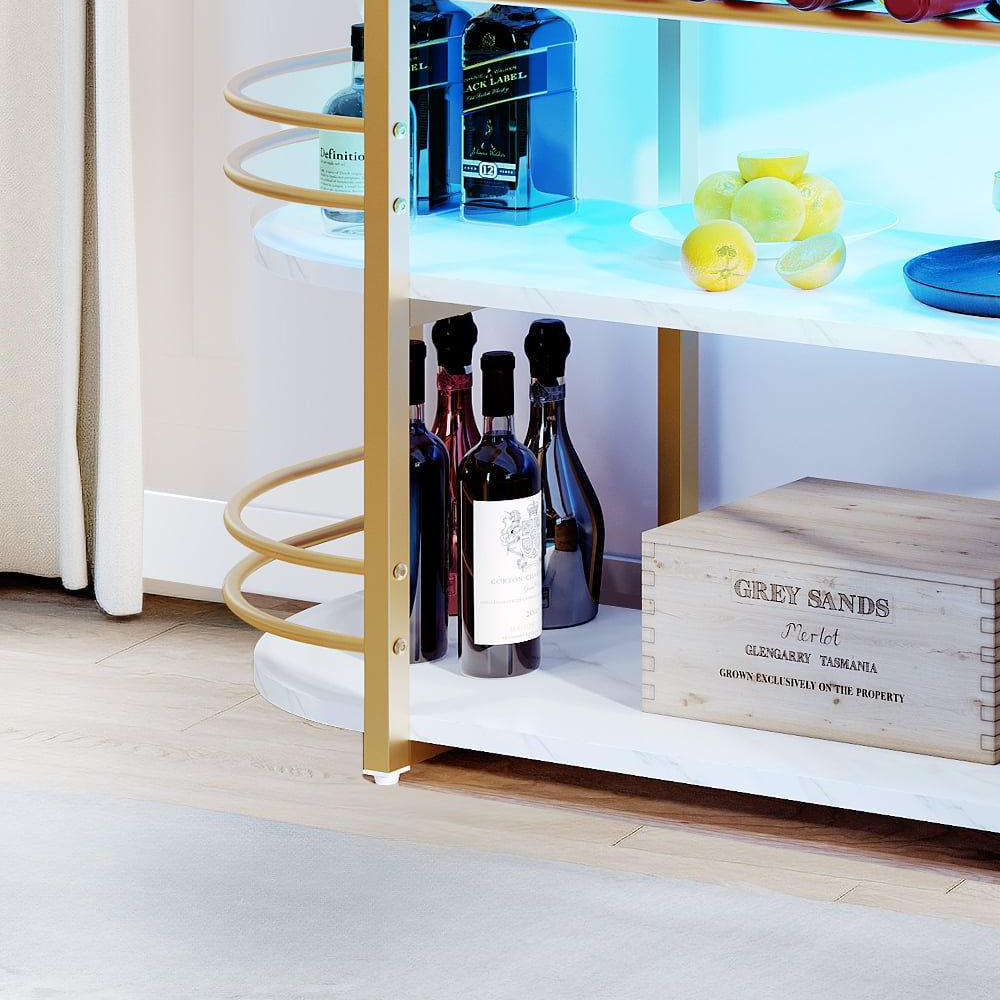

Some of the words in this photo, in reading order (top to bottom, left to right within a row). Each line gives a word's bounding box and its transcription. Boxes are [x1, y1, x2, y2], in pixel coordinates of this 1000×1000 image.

[490, 71, 527, 86] LABEL
[482, 165, 494, 177] 12
[733, 578, 801, 605] GREY
[807, 589, 890, 618] SANDS
[781, 622, 841, 647] Merlot
[745, 644, 812, 664] GLENGARRY
[819, 655, 878, 674] TASMANIA
[719, 667, 753, 681] GROWN
[756, 672, 816, 691] EXCLUSIVELY
[818, 682, 833, 692] ON
[835, 684, 853, 696] THE
[856, 687, 905, 704] PROPERTY
